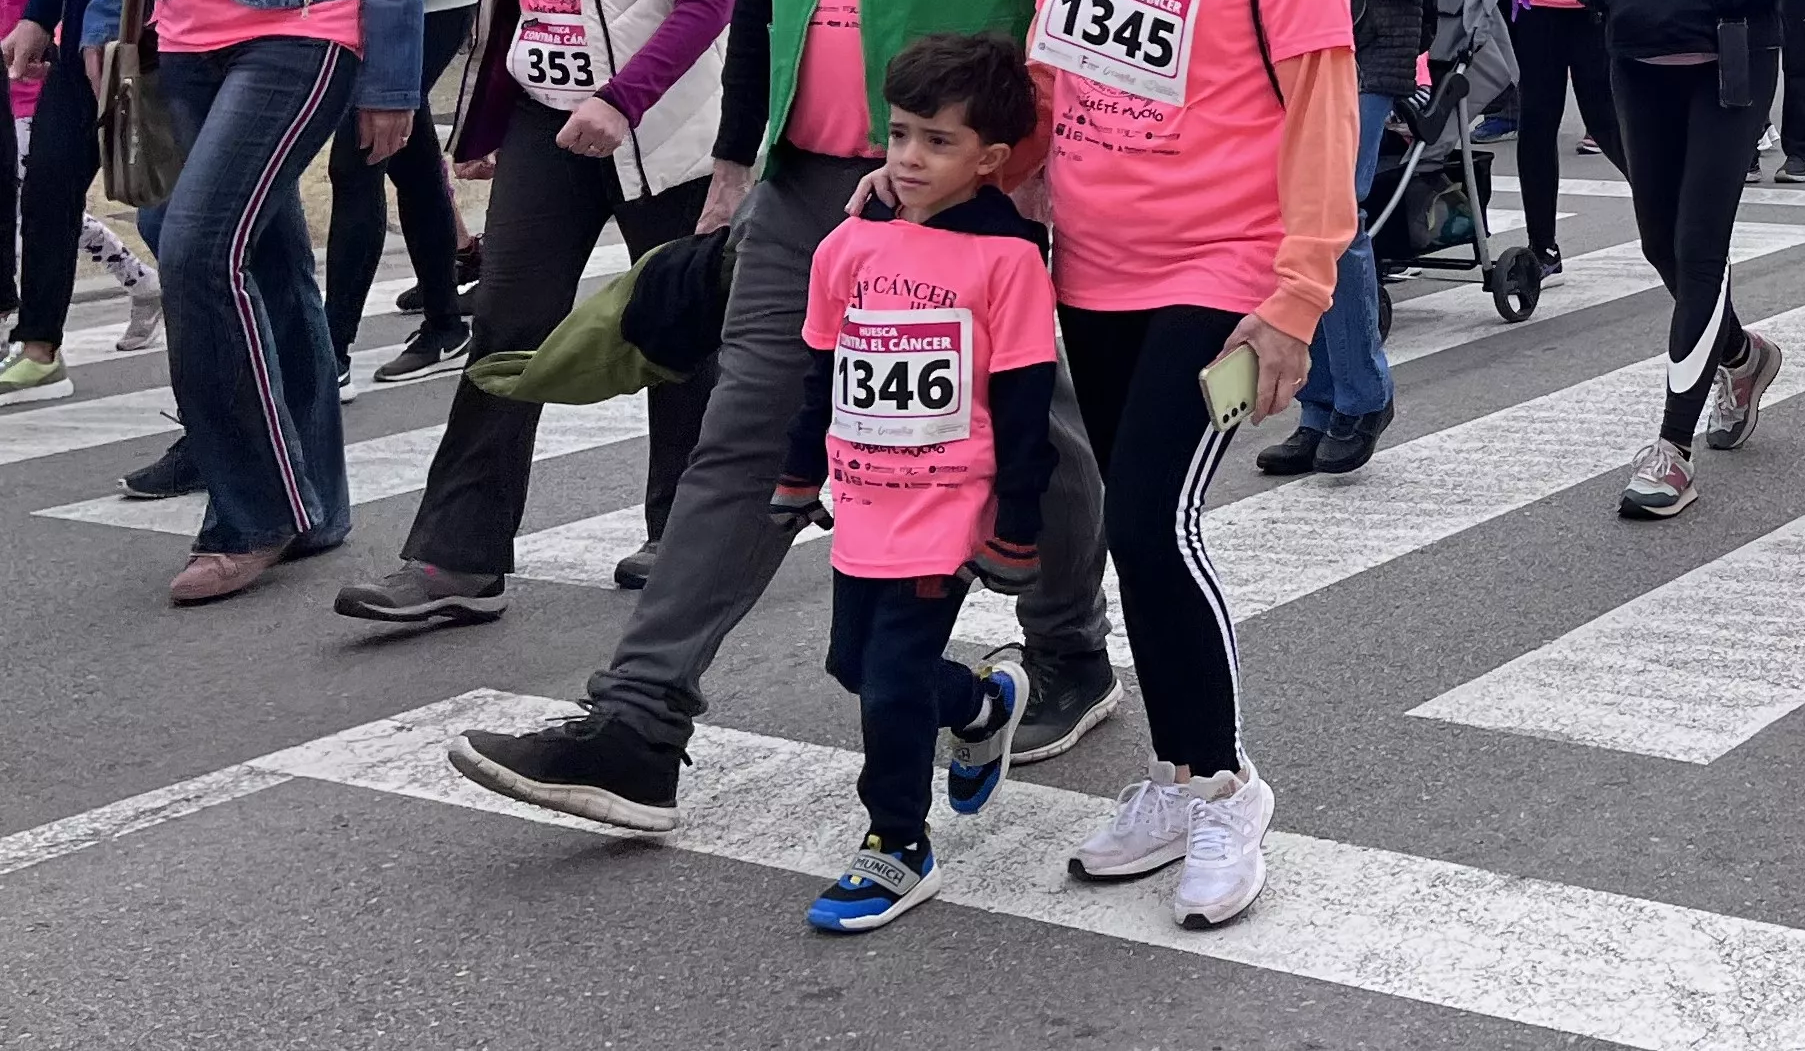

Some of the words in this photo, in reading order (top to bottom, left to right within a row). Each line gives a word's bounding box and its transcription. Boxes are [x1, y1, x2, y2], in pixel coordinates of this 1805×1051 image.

[527, 48, 595, 87] 353
[873, 273, 957, 308] CÁNCER
[858, 327, 899, 337] HUESCA
[870, 338, 886, 351] EL
[888, 335, 953, 351] CÁNCER
[838, 357, 954, 410] 1346
[853, 858, 905, 887] MUNICH
